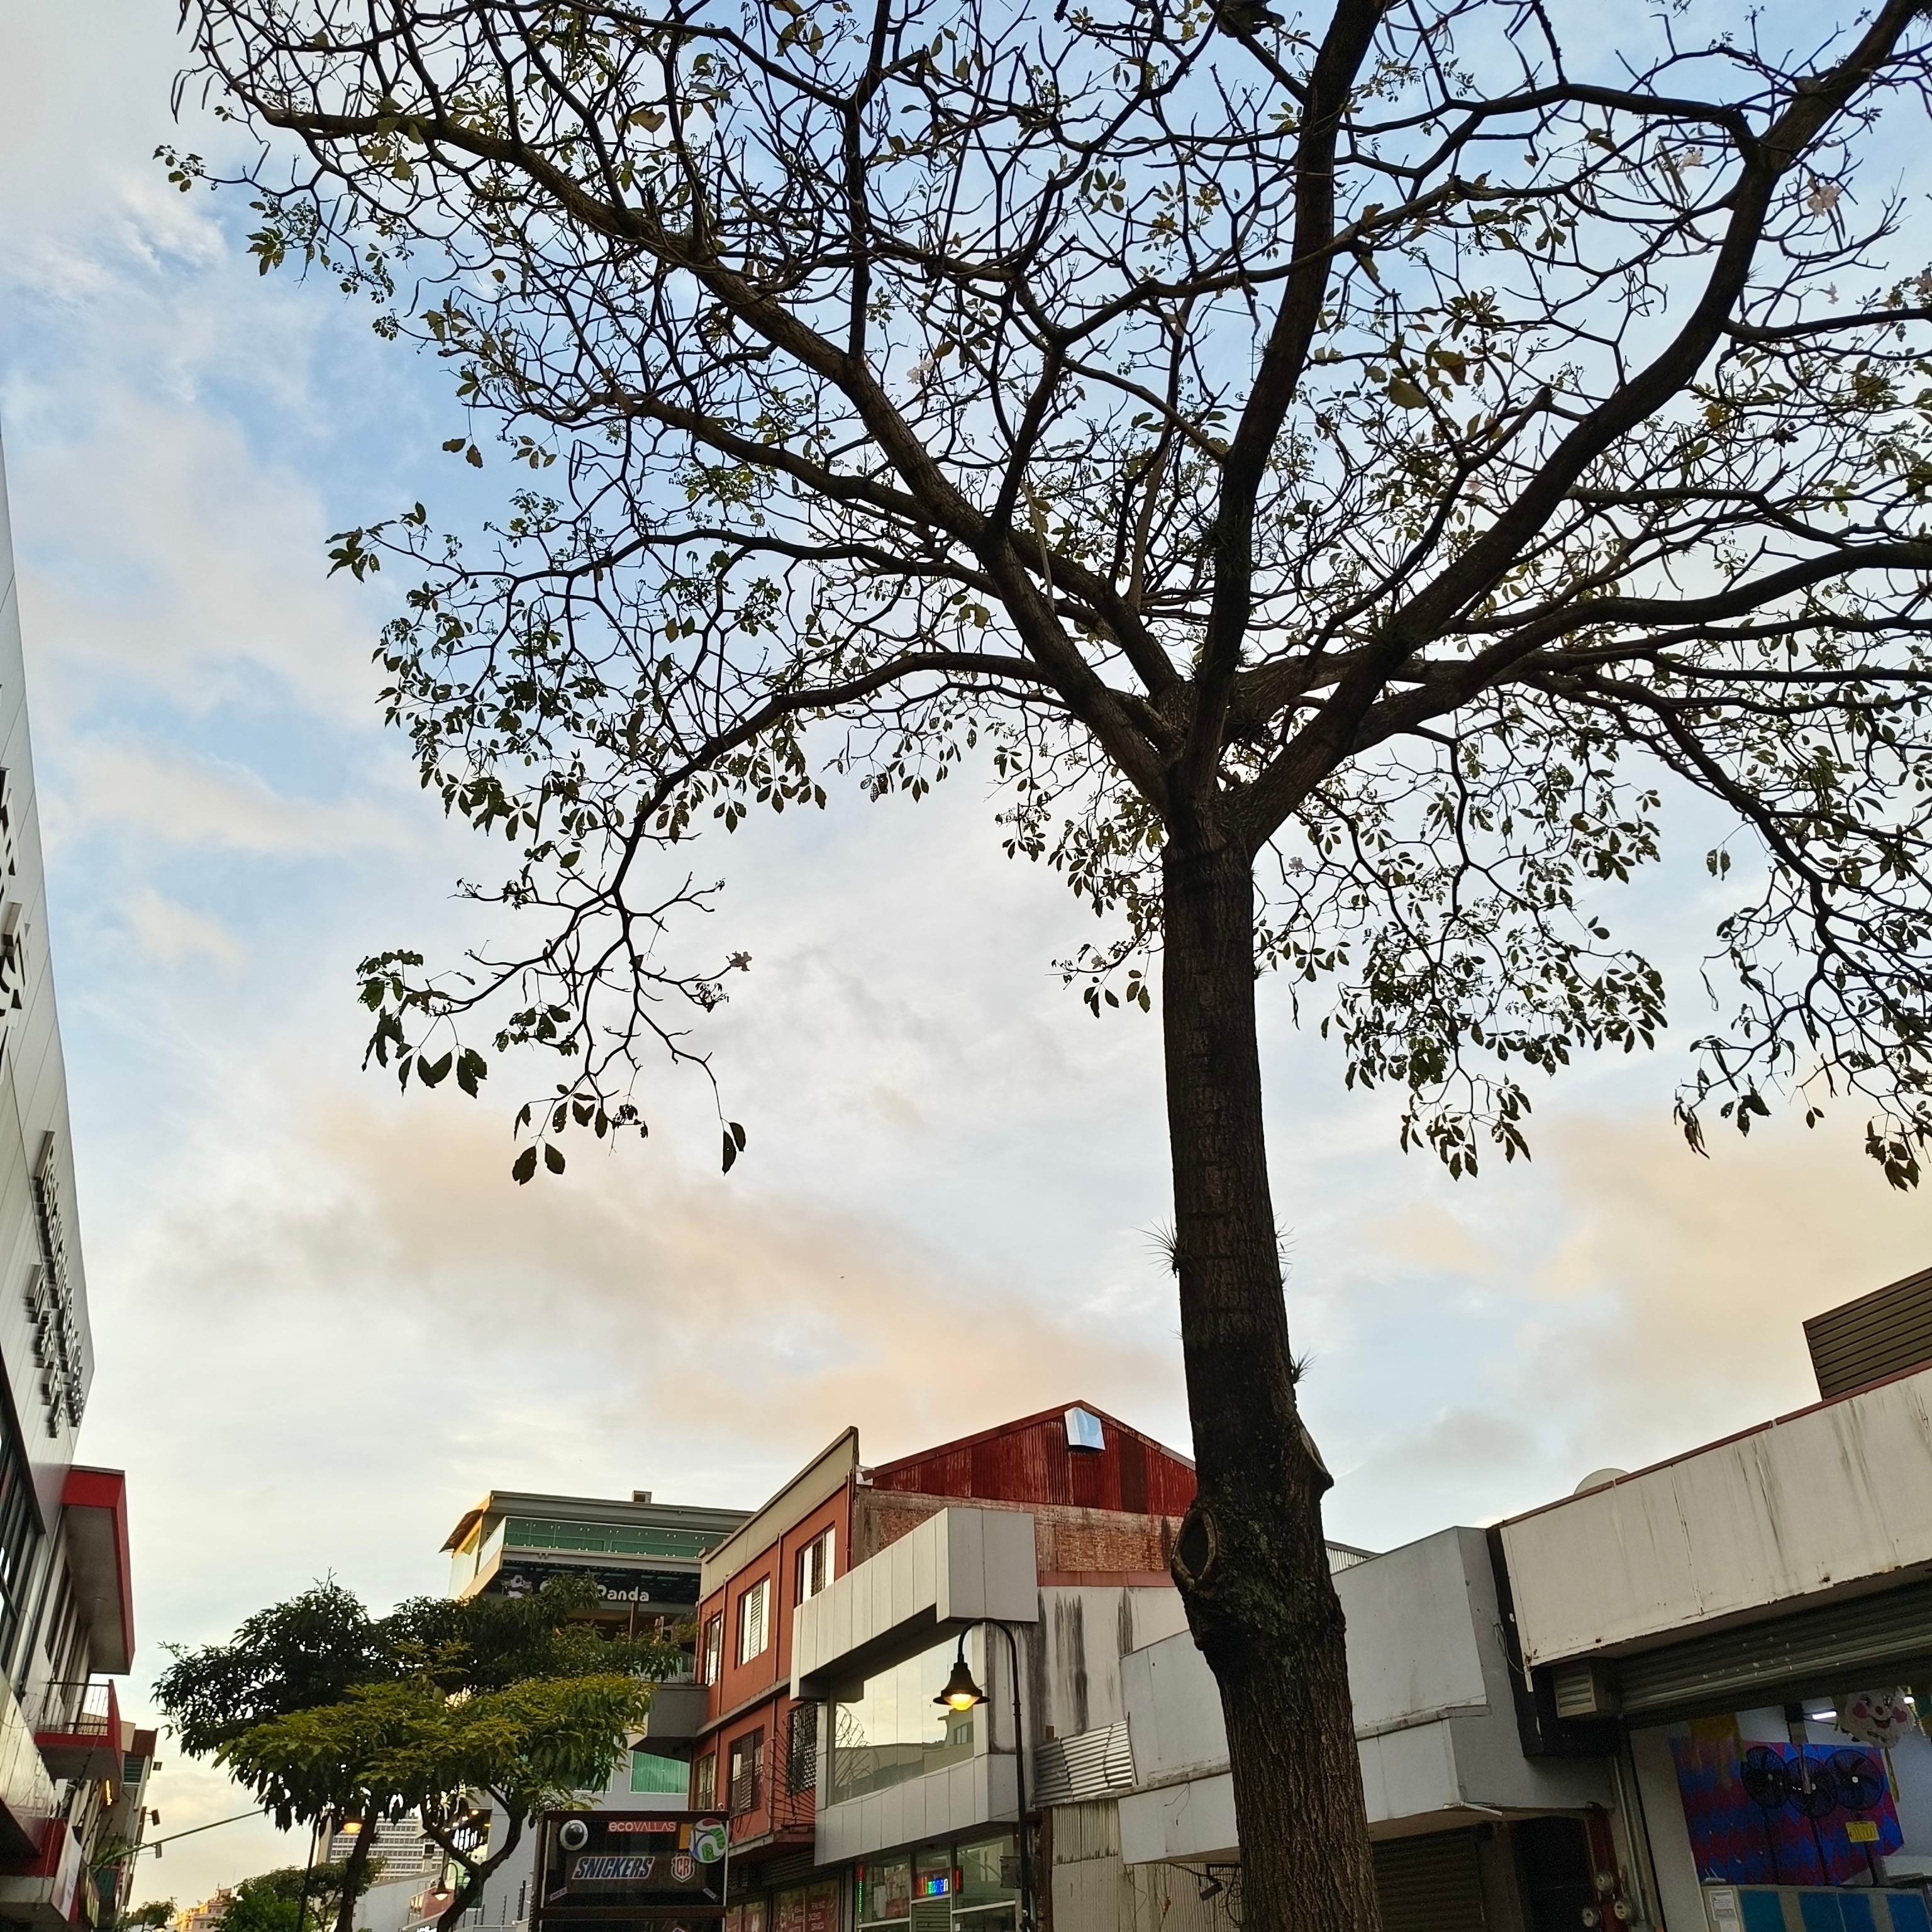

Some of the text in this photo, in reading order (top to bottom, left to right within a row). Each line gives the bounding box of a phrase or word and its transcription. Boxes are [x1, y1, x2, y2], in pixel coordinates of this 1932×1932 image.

[38, 1131, 68, 1310] Restaurante
[62, 1287, 79, 1373] Grand
[608, 1821, 676, 1832] ecoVALLAS
[574, 1857, 654, 1879] SNICKERS
